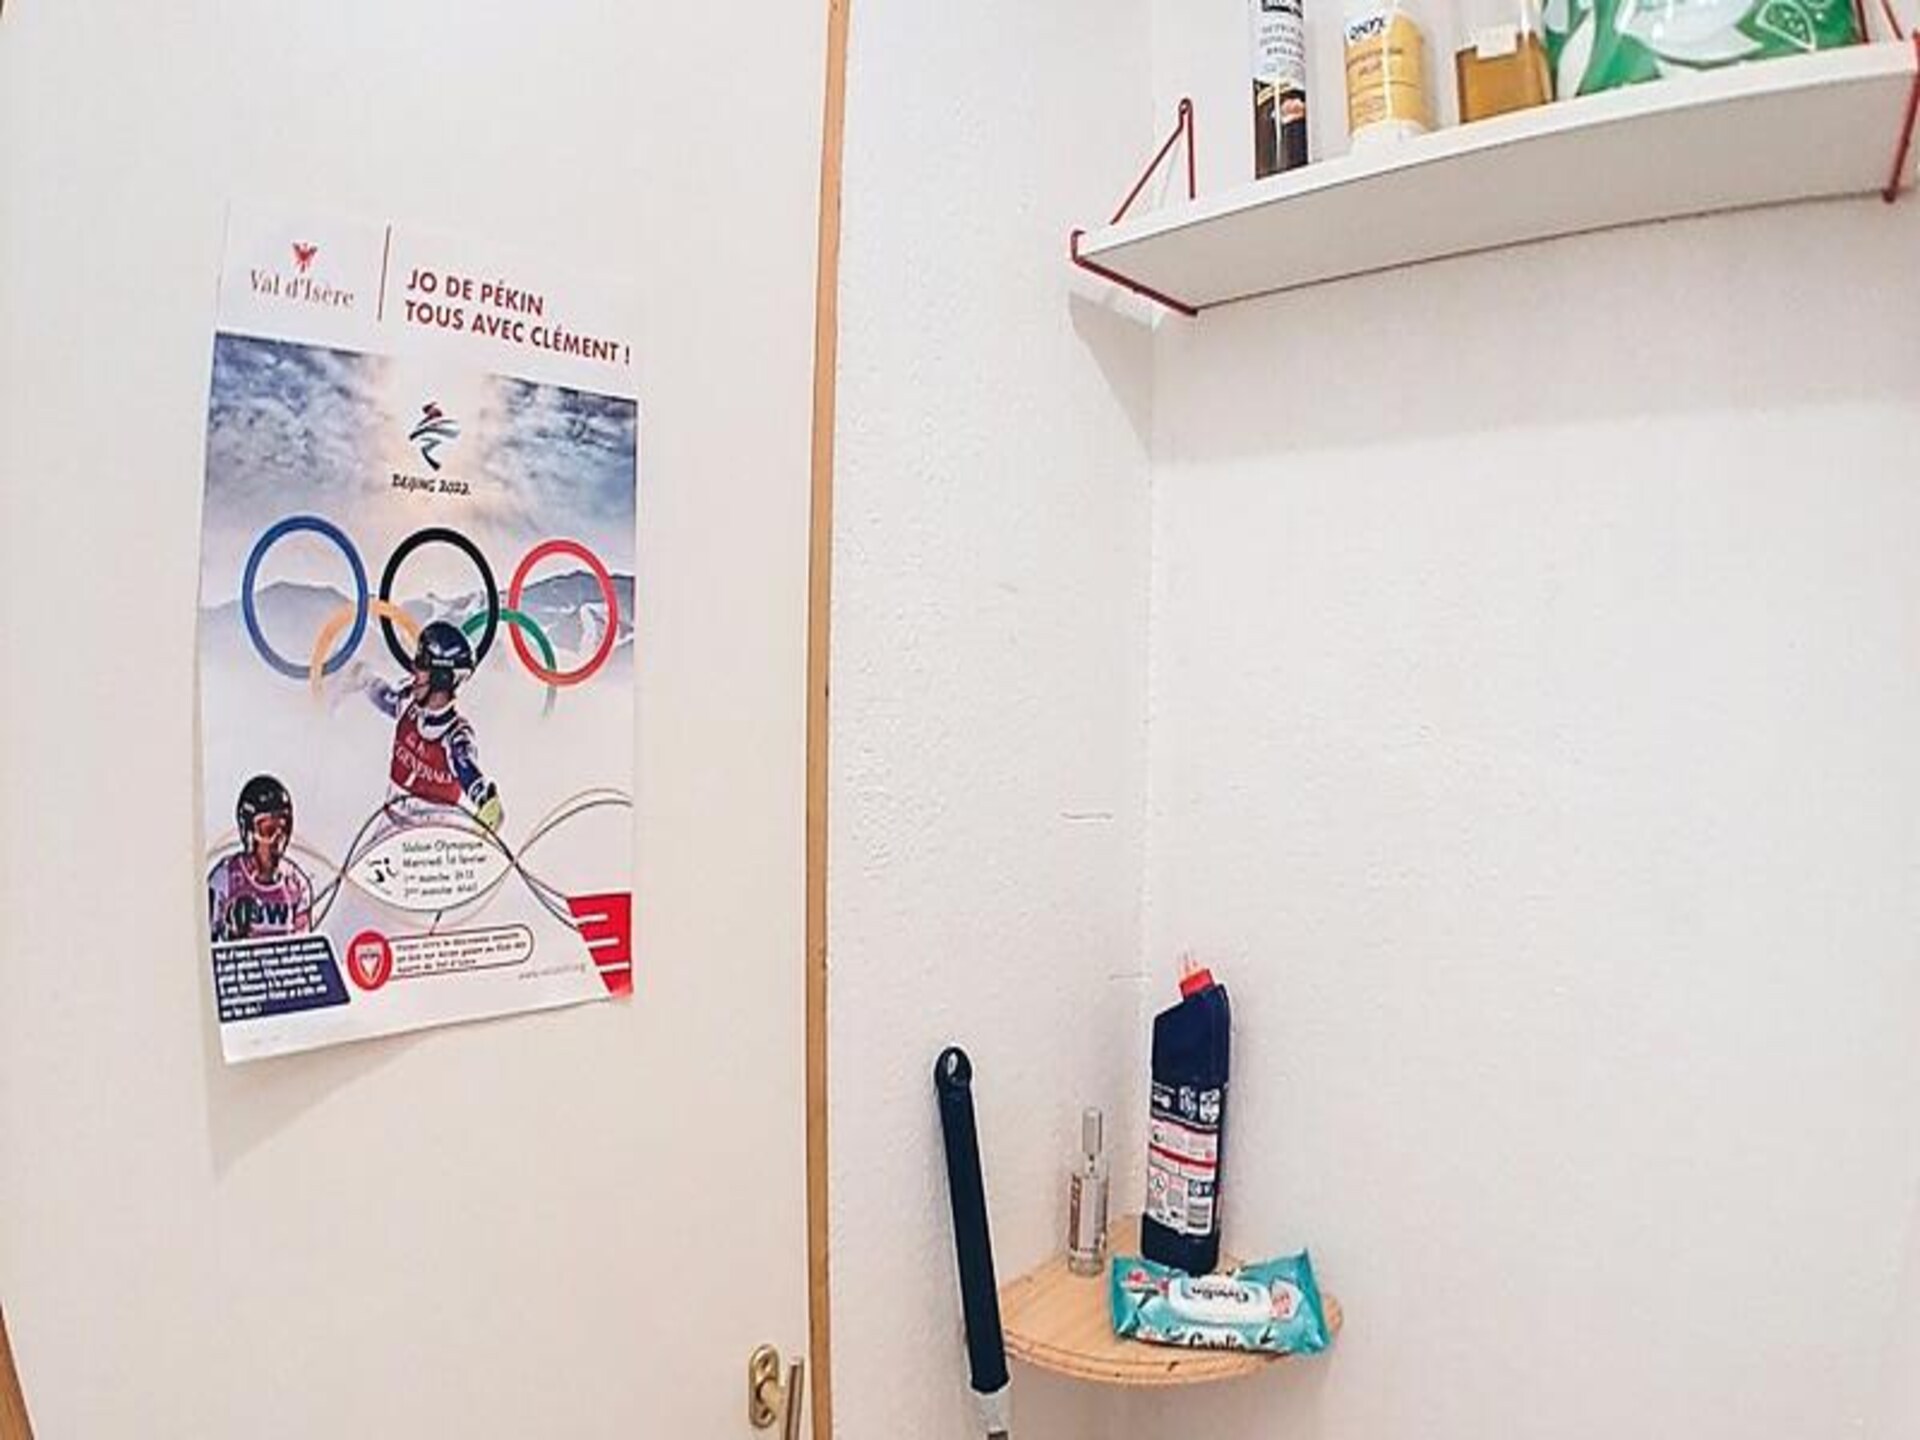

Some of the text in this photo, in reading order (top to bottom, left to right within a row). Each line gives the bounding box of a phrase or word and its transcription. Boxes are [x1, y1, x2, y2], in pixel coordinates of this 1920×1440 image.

[251, 268, 280, 296] Val
[407, 268, 544, 316] JO DE PÉKIN
[405, 300, 465, 331] TOUS
[471, 309, 534, 343] AVEC
[530, 320, 619, 362] CLÉMENT
